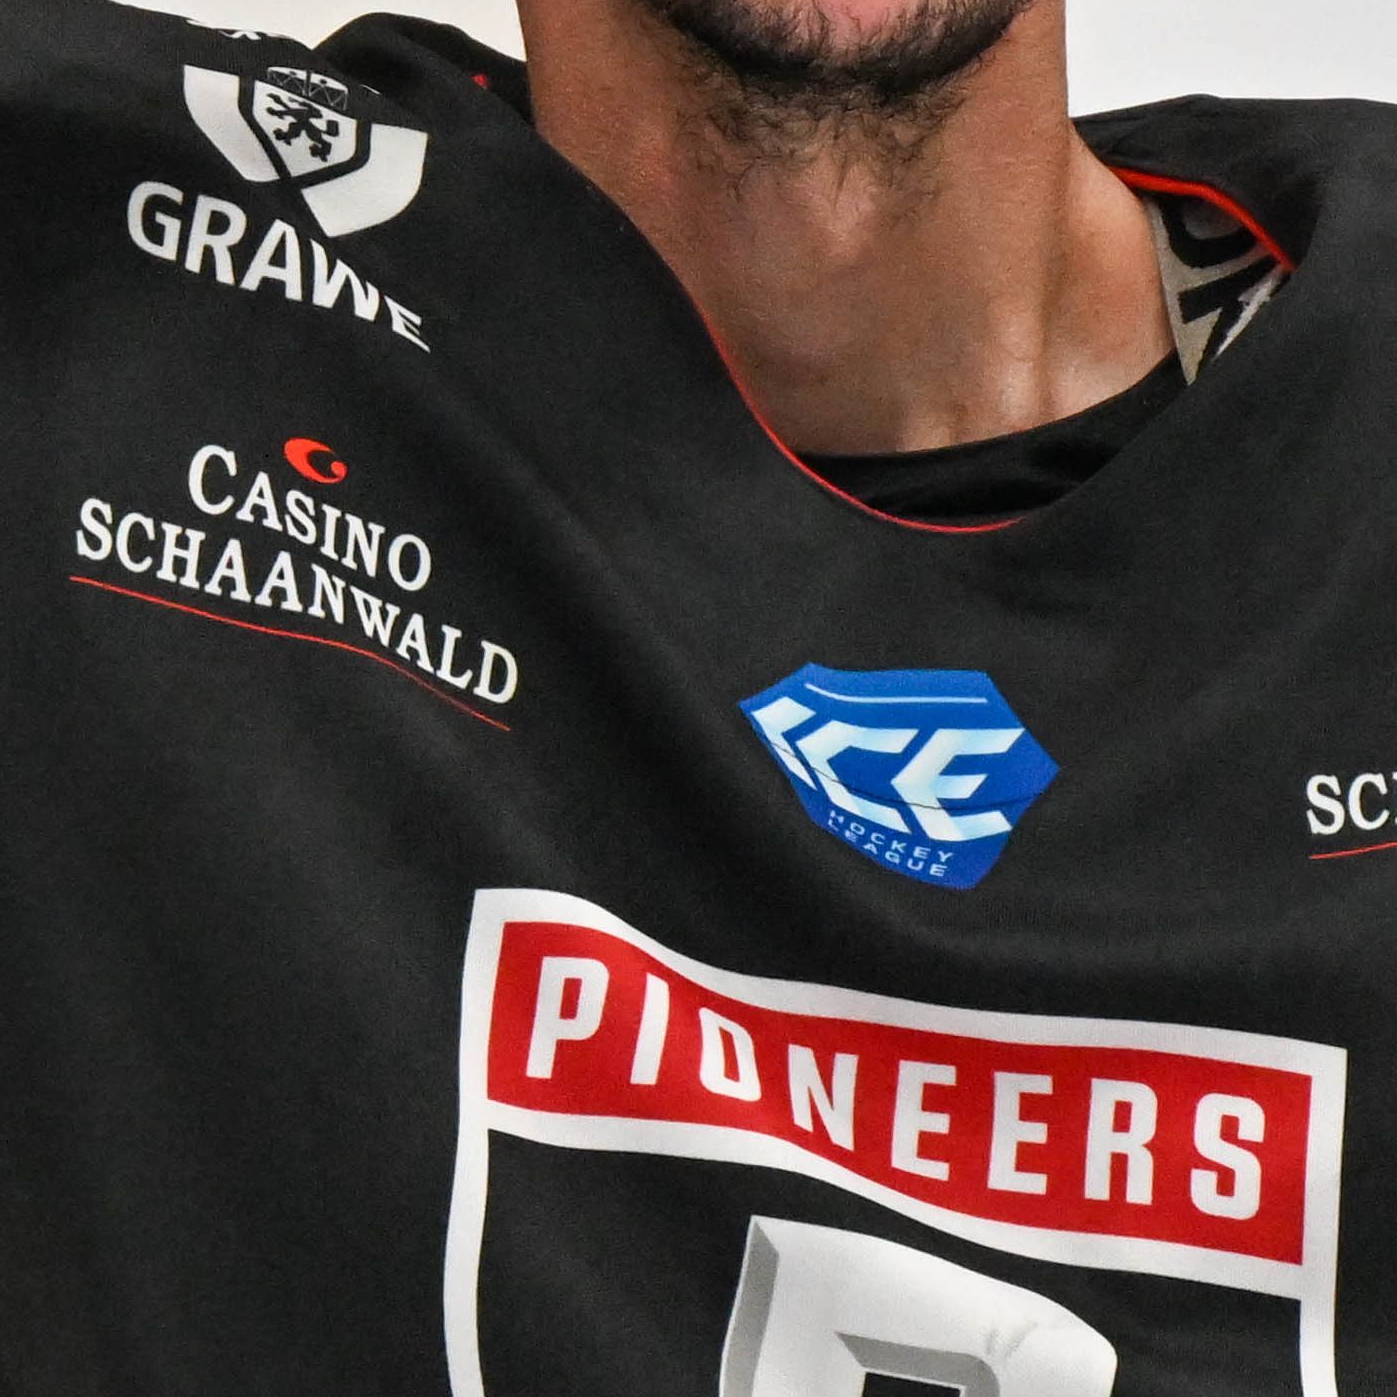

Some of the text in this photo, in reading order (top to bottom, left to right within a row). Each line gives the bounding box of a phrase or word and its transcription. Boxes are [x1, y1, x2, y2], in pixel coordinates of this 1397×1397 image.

[125, 179, 432, 354] GRAWE
[187, 444, 433, 593] CASINO
[74, 497, 519, 705] SCHAANWALD
[750, 695, 1026, 842] ICE
[828, 809, 954, 864] HOCKEY
[827, 817, 949, 878] LEAGUE
[526, 954, 1268, 1222] PIONEERS
